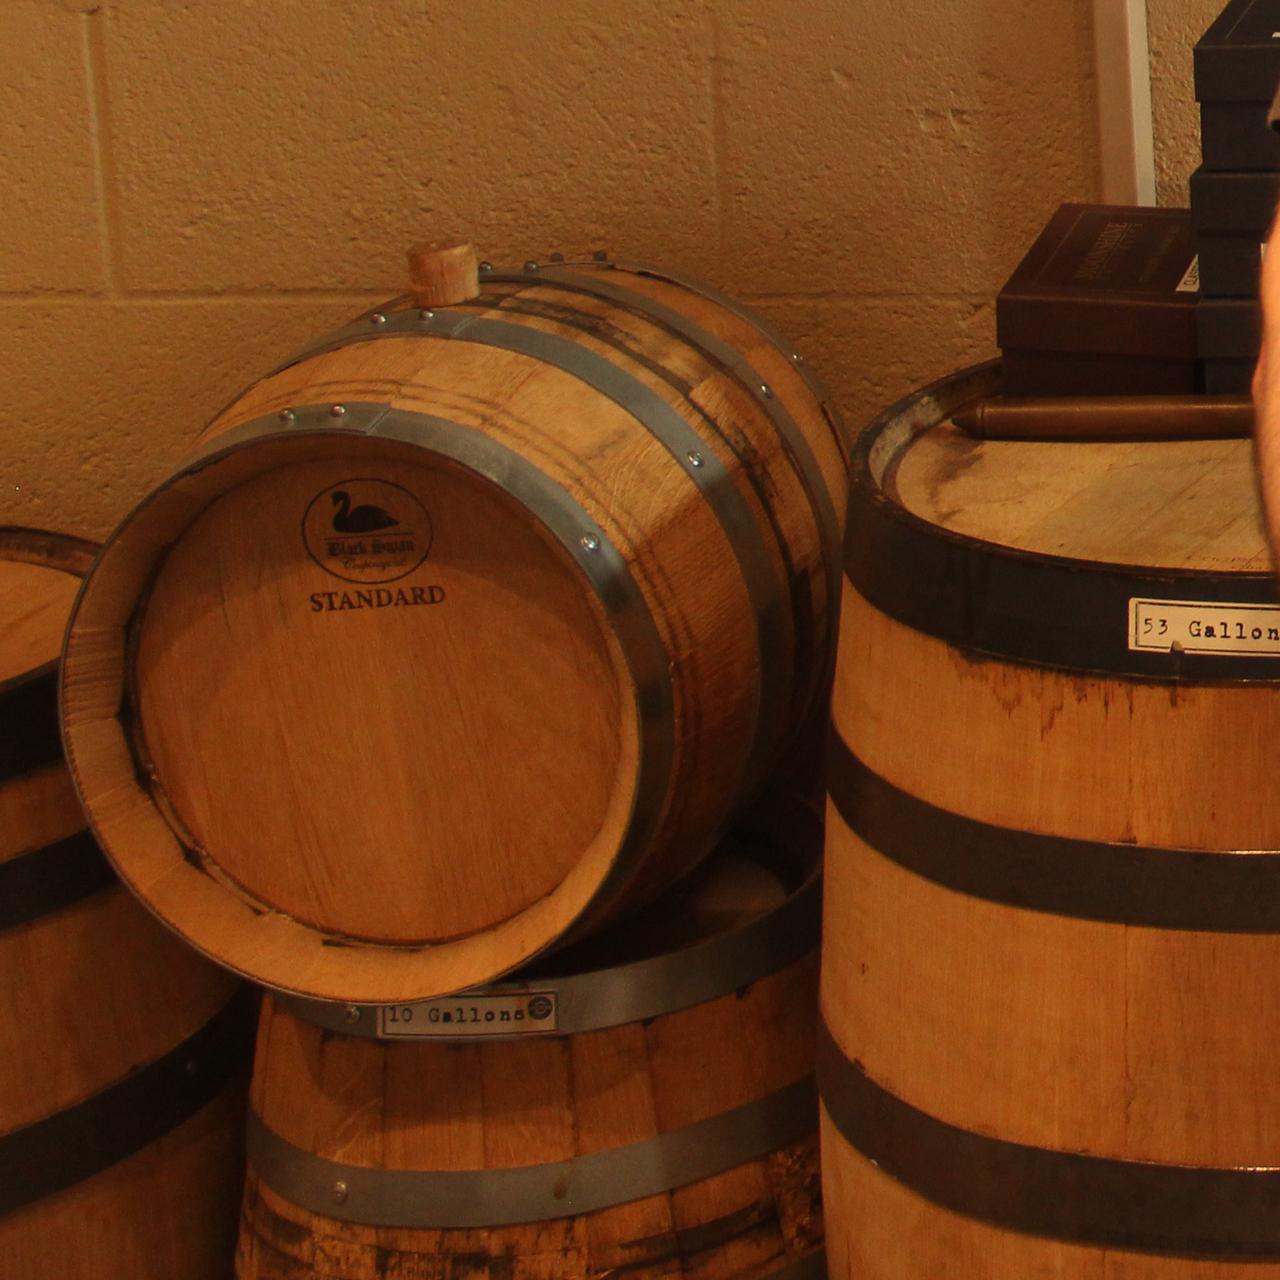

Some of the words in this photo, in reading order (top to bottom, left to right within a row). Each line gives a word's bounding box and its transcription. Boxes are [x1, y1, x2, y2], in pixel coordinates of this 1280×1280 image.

[309, 585, 447, 612] STANDARD
[1143, 618, 1168, 636] 53
[389, 1007, 413, 1023] 10
[428, 1006, 526, 1024] Gallons
